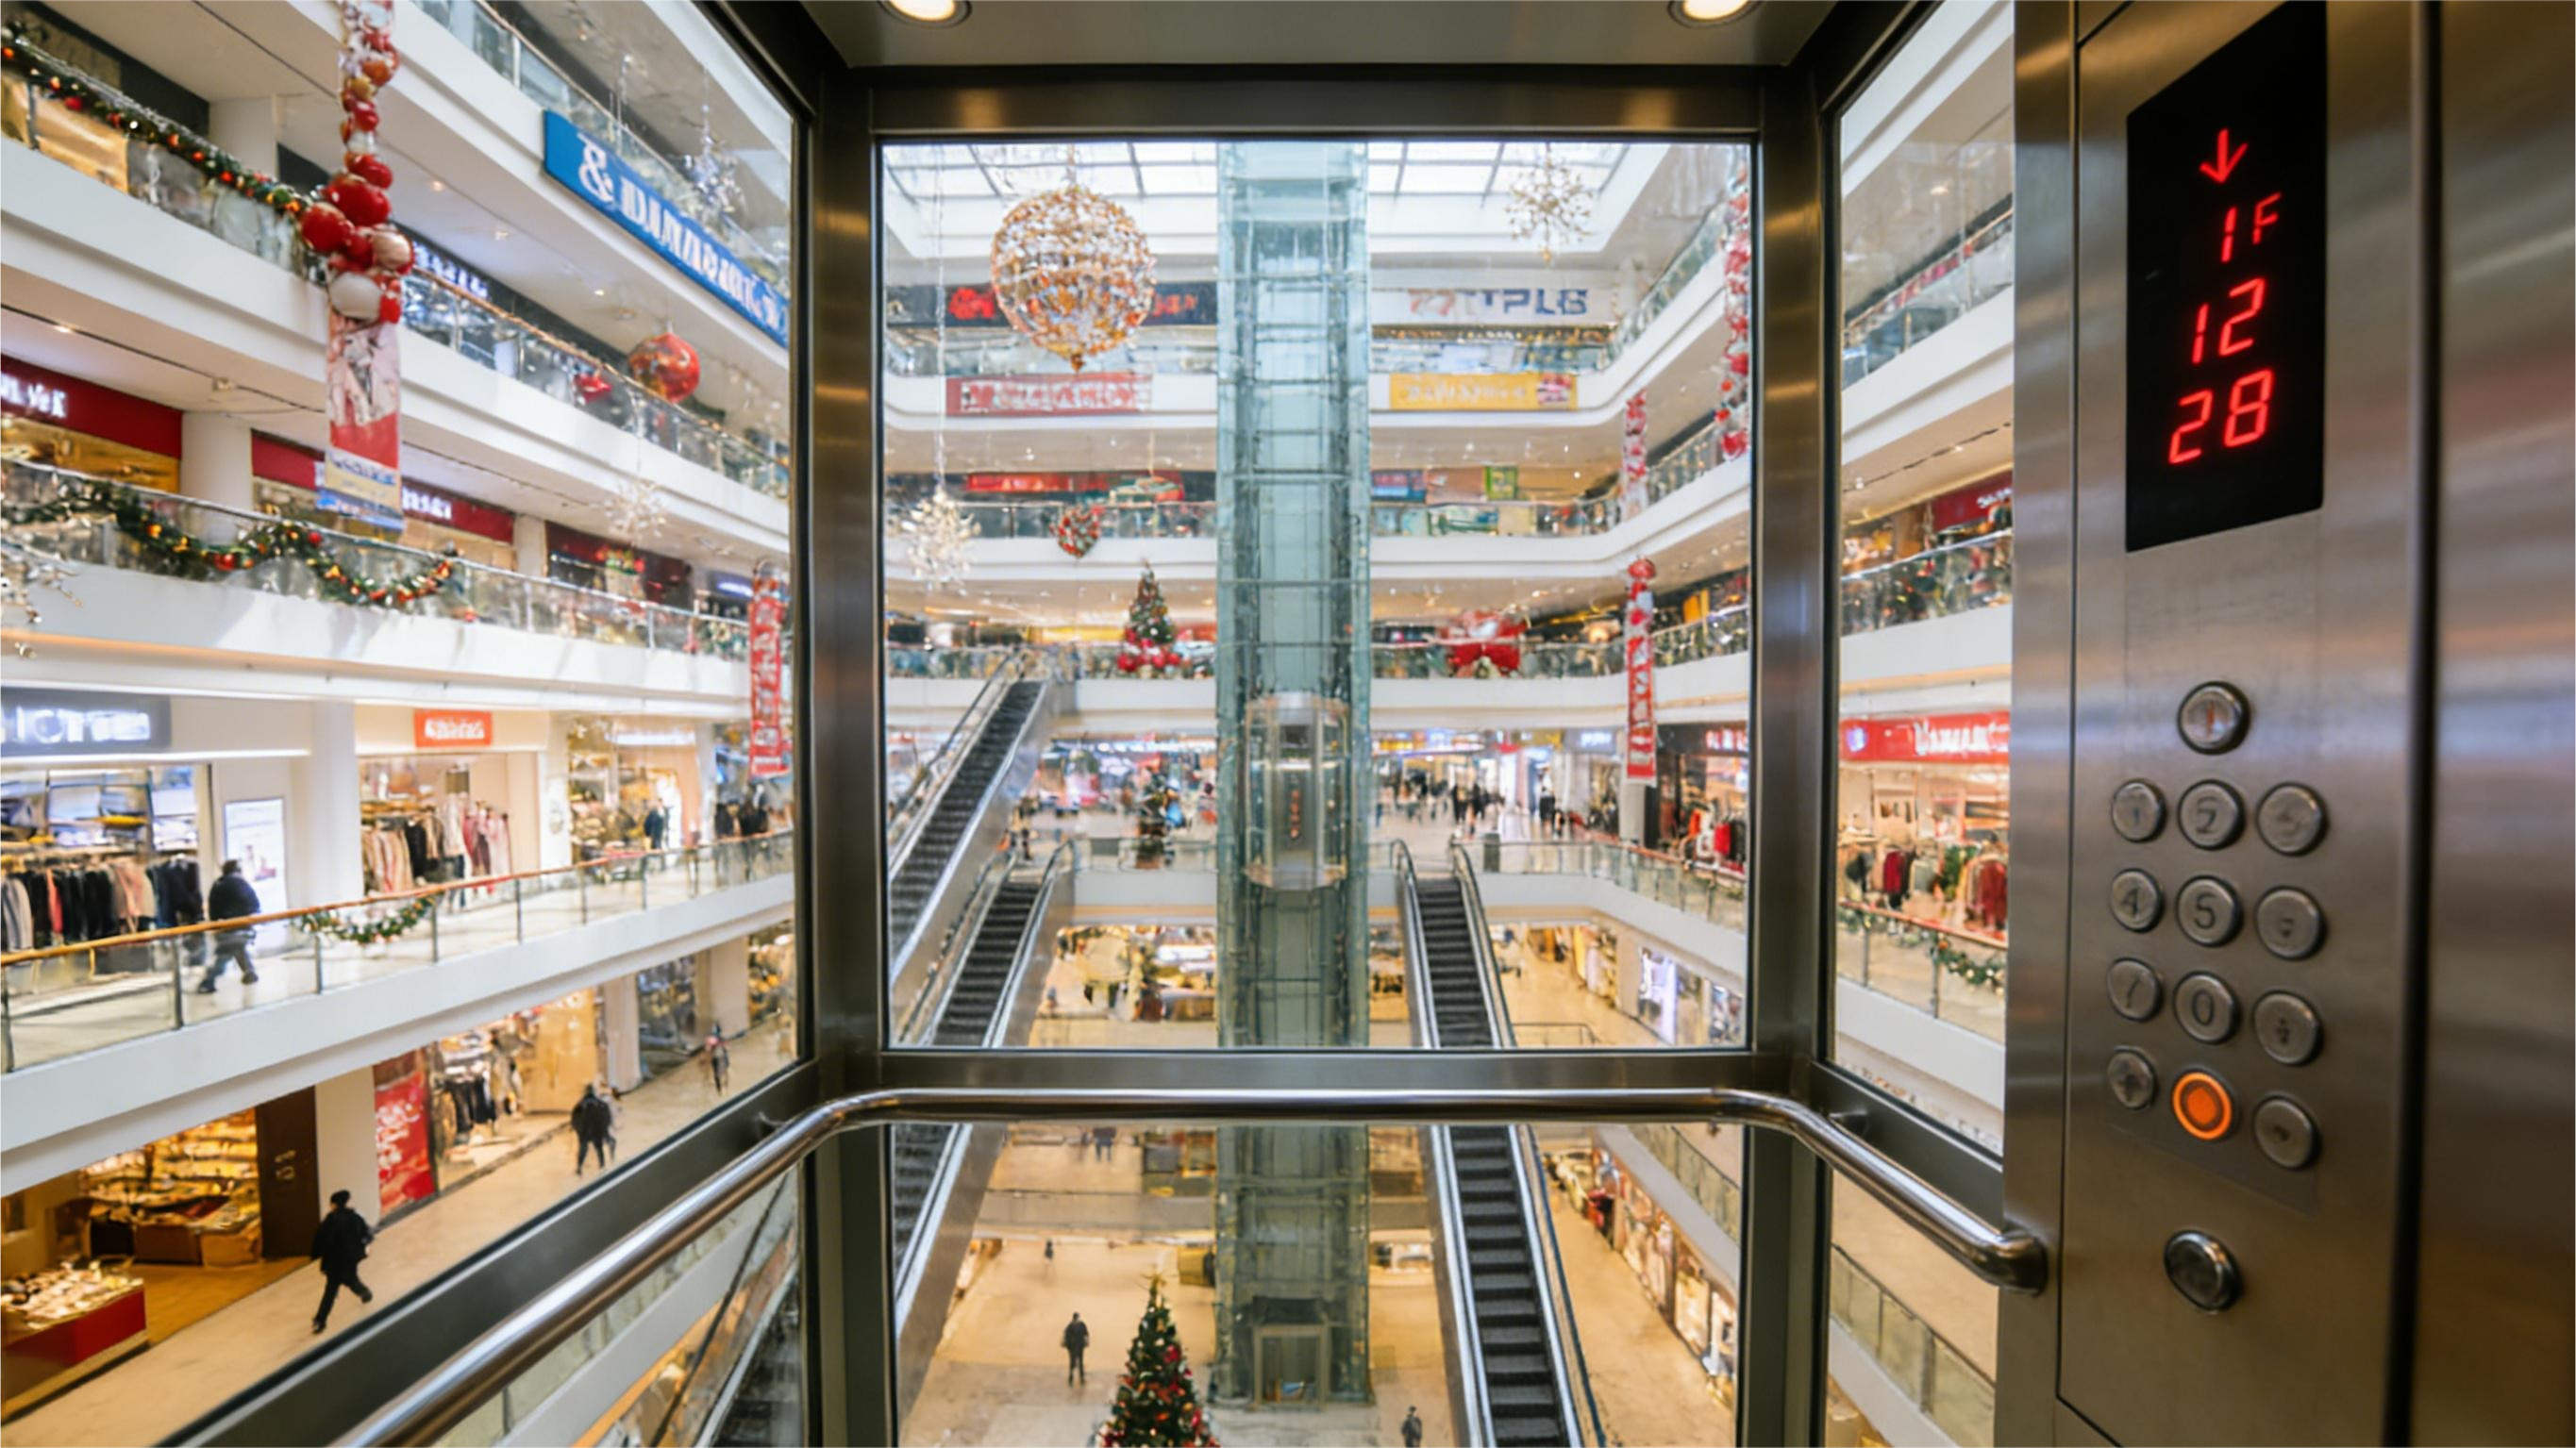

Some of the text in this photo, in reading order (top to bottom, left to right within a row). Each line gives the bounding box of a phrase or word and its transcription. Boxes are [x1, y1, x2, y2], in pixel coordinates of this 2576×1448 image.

[2221, 192, 2281, 263] 1F
[2191, 277, 2266, 364] 12
[2168, 369, 2274, 464] 28
[2192, 891, 2218, 930] 5
[2191, 987, 2216, 1026] 0
